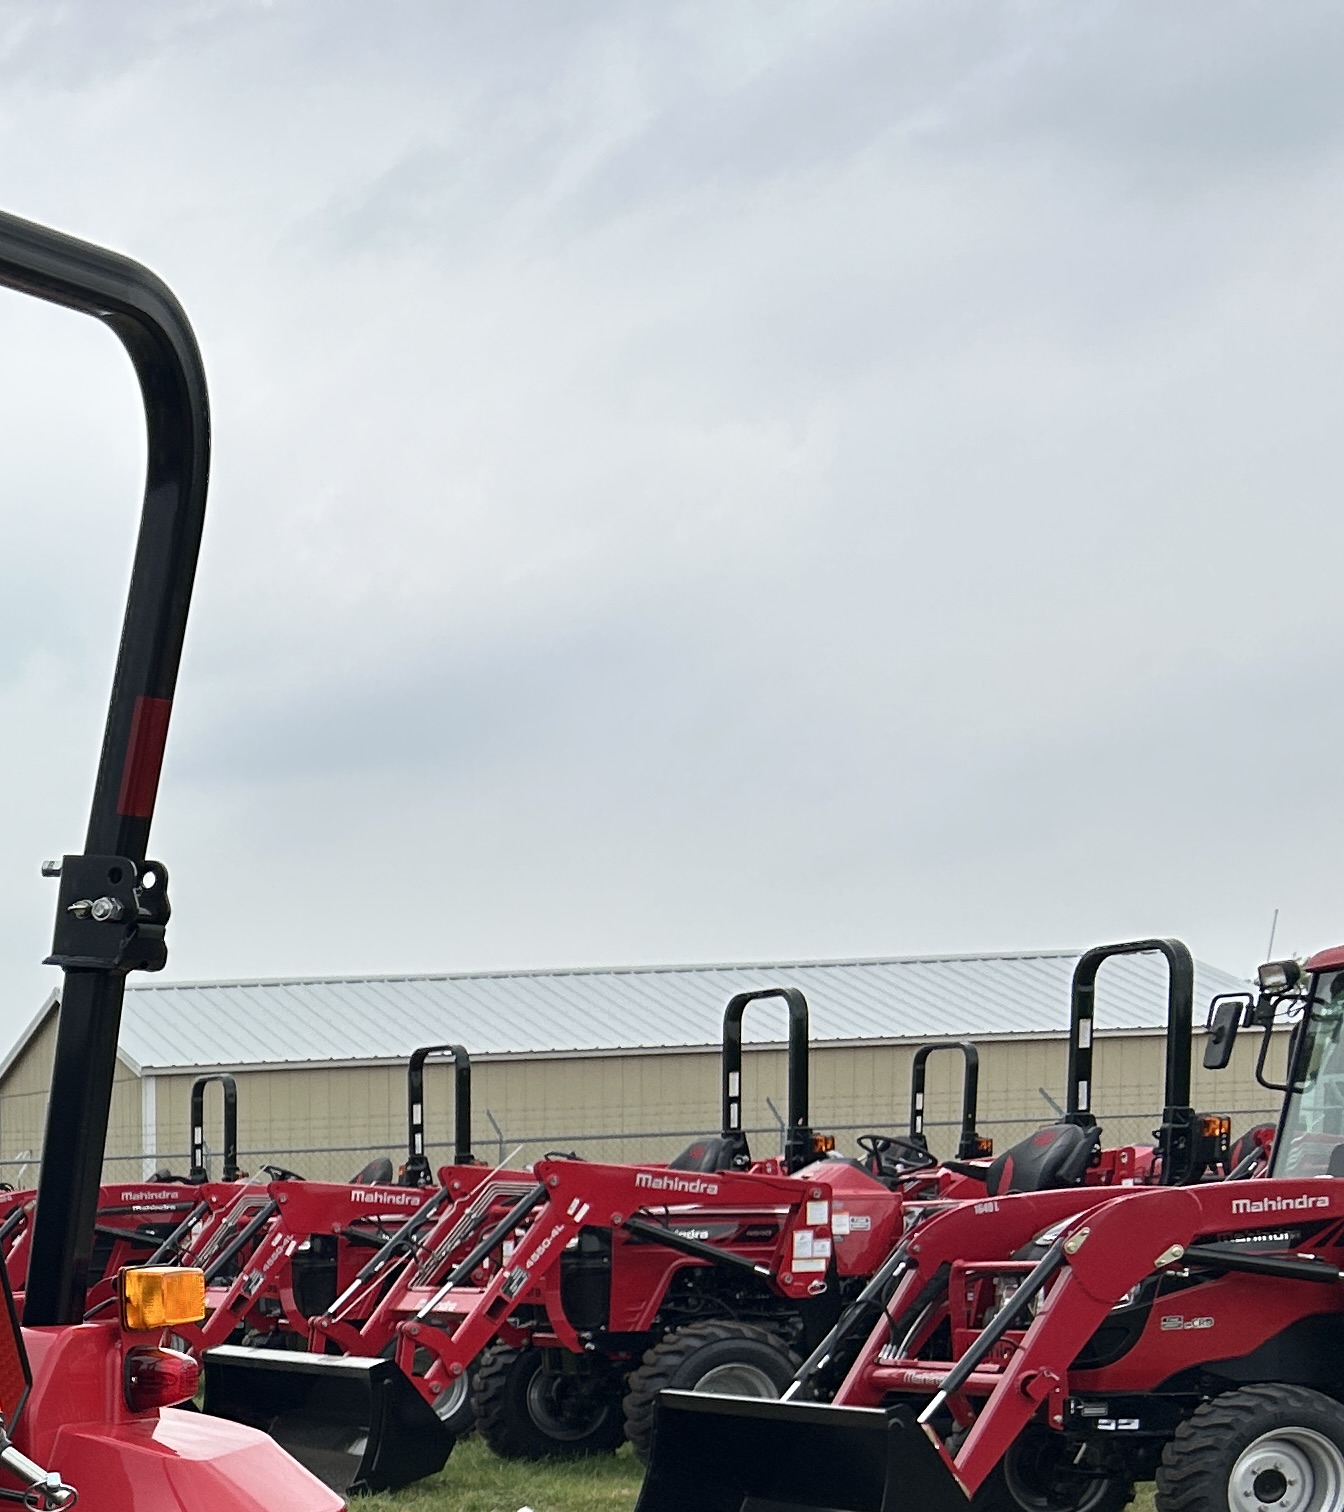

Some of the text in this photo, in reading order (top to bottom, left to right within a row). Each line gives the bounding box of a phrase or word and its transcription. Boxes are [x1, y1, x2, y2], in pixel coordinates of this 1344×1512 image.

[635, 1173, 718, 1196] Mahindra
[121, 1190, 179, 1201] Mahindra
[351, 1189, 421, 1207] Mahindra
[1232, 1194, 1330, 1214] Mahindra
